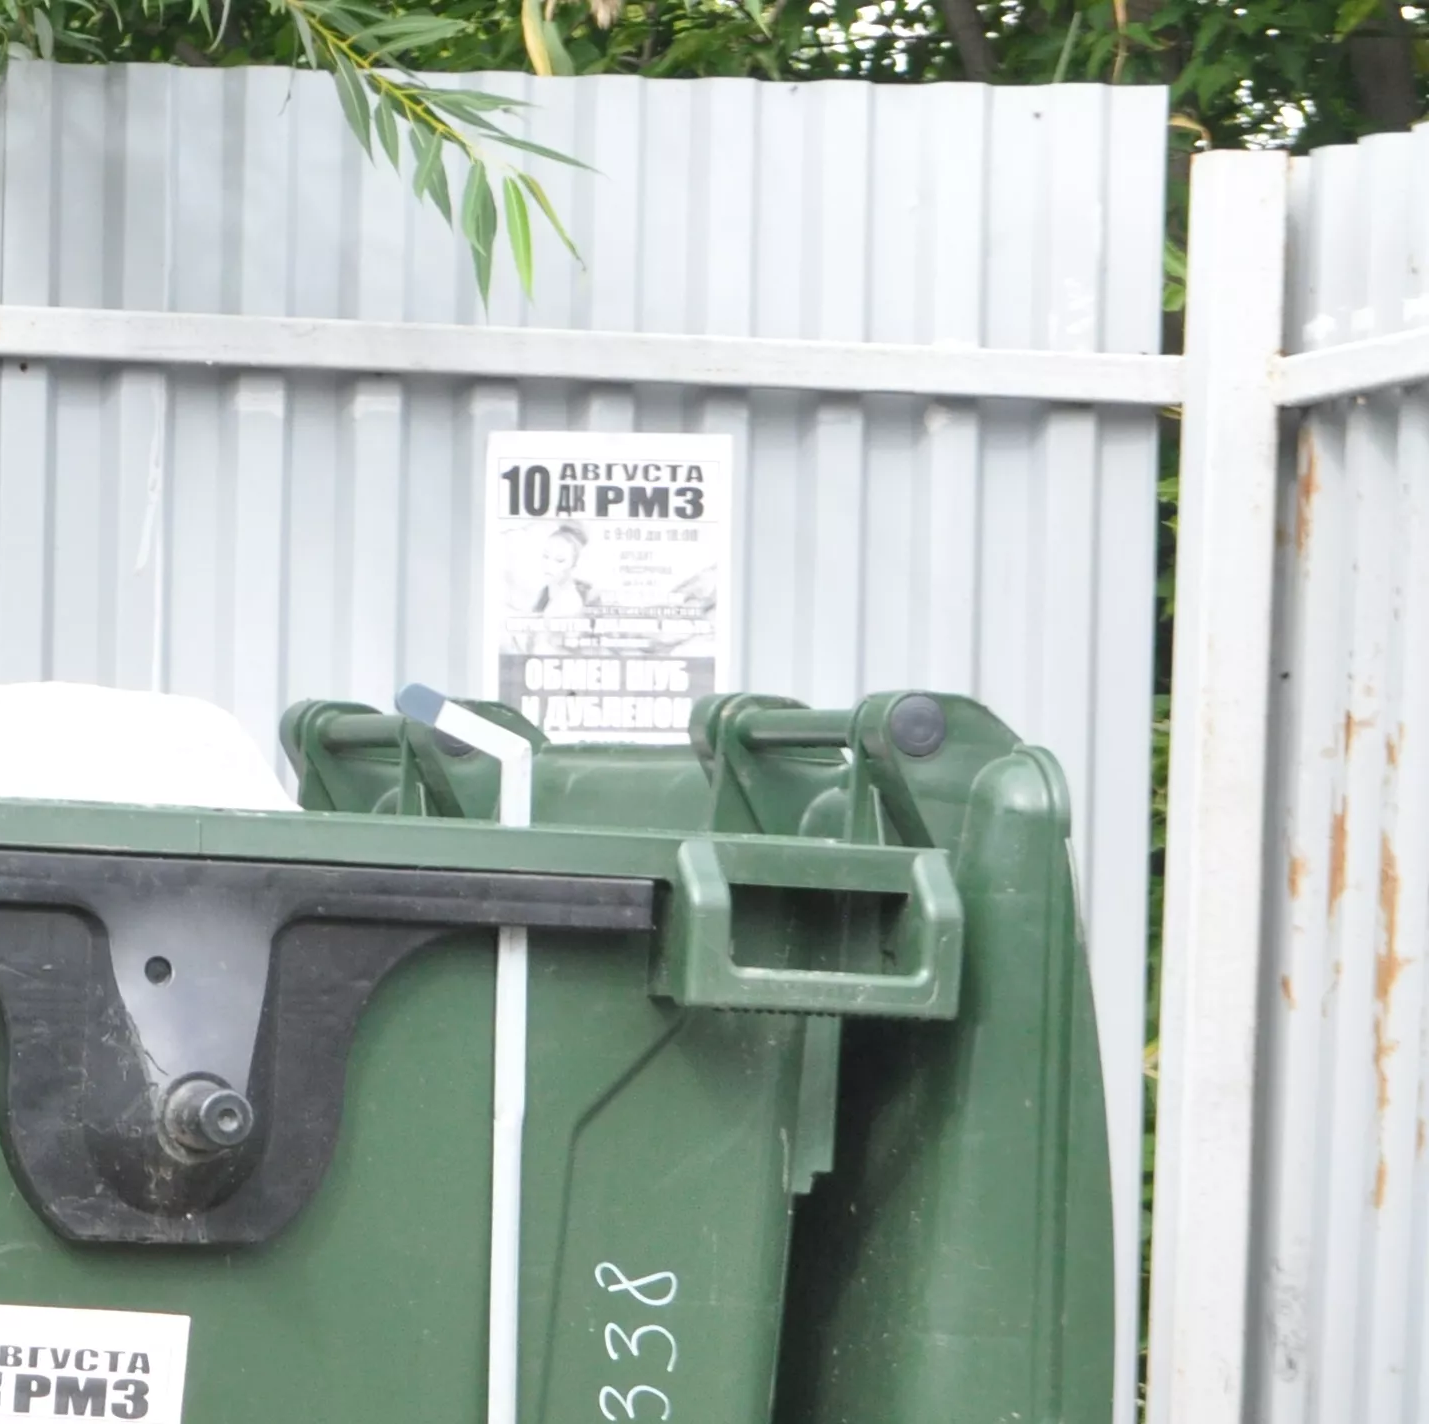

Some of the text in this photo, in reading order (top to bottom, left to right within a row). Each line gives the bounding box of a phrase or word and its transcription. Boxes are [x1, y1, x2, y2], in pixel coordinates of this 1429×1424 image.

[501, 463, 704, 518] 10 АВГУСТА
[556, 484, 705, 520] ДК РМЗ
[525, 658, 689, 692] ОБМЕН ШУБ
[13, 1374, 150, 1420] РМЗ
